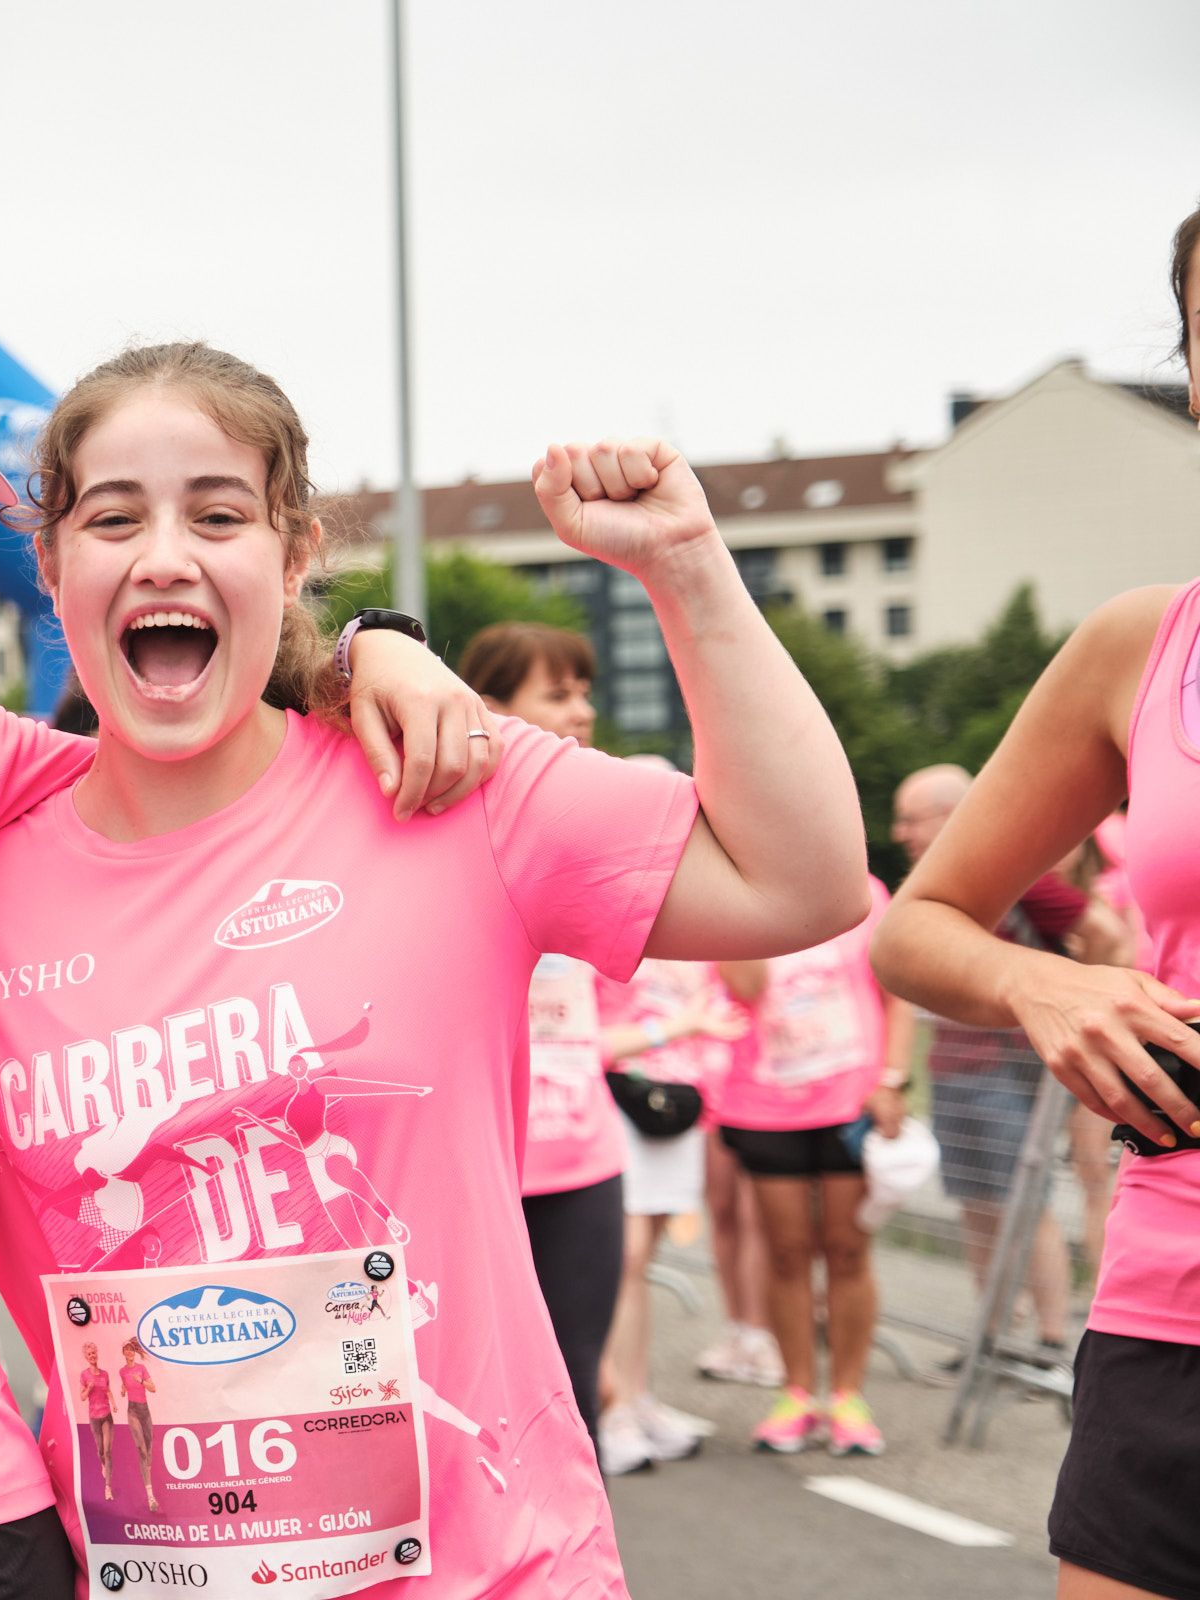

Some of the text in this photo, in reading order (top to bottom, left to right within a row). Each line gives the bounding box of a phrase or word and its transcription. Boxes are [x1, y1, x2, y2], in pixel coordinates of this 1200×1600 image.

[241, 887, 328, 917] CENTRAL LECHERA
[223, 895, 335, 941] ASTURIANA
[173, 1117, 305, 1263] DE
[86, 1292, 127, 1304] DORSAL
[325, 1302, 360, 1313] Carrera
[89, 1304, 131, 1325] UMA
[168, 1307, 277, 1324] CENTRAL LECHERA
[149, 1318, 285, 1348] ASTURIANA
[330, 1383, 373, 1405] gijón
[304, 1411, 407, 1433] CORREDORA
[163, 1419, 297, 1480] 016
[166, 1475, 292, 1490] TELÉFONO VIOLENCIA DE GÉNERO
[208, 1489, 258, 1515] 904
[124, 1524, 185, 1542] CARRERA
[189, 1525, 209, 1542] DE
[214, 1523, 236, 1541] LA
[241, 1518, 302, 1539] MUJER
[319, 1508, 372, 1532] GIJÓN
[123, 1559, 208, 1588] OYSHO
[282, 1550, 388, 1583] Santander
